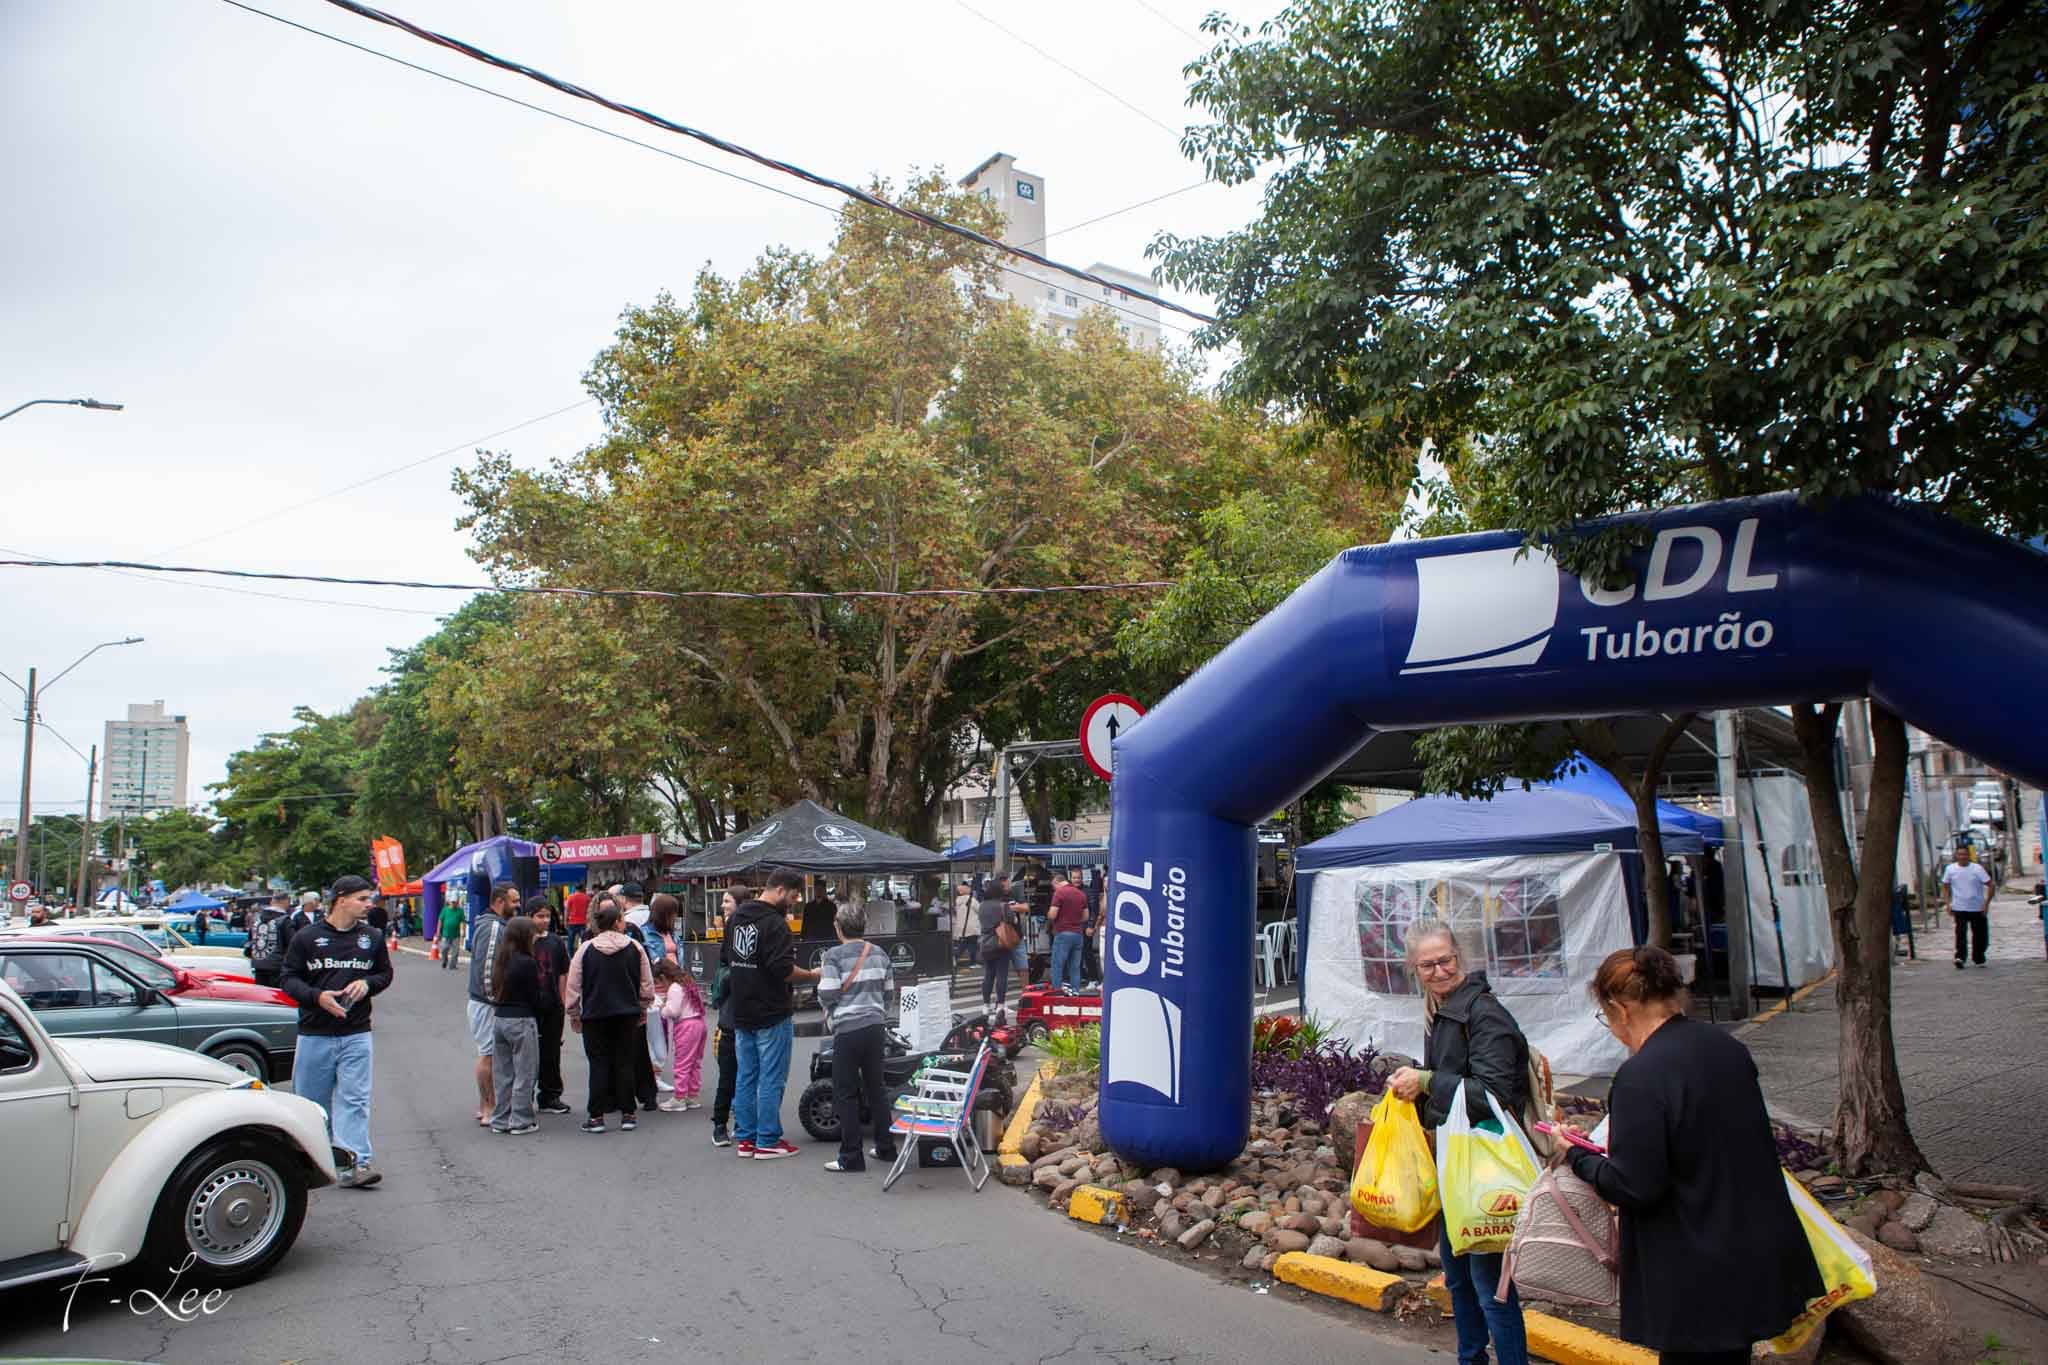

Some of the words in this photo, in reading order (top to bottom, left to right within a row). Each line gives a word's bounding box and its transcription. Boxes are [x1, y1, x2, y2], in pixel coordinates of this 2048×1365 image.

[1580, 611, 1774, 661] Tubarão
[1113, 861, 1153, 976] CDL
[1160, 867, 1186, 978] Tubarão
[1461, 1226, 1471, 1237] A
